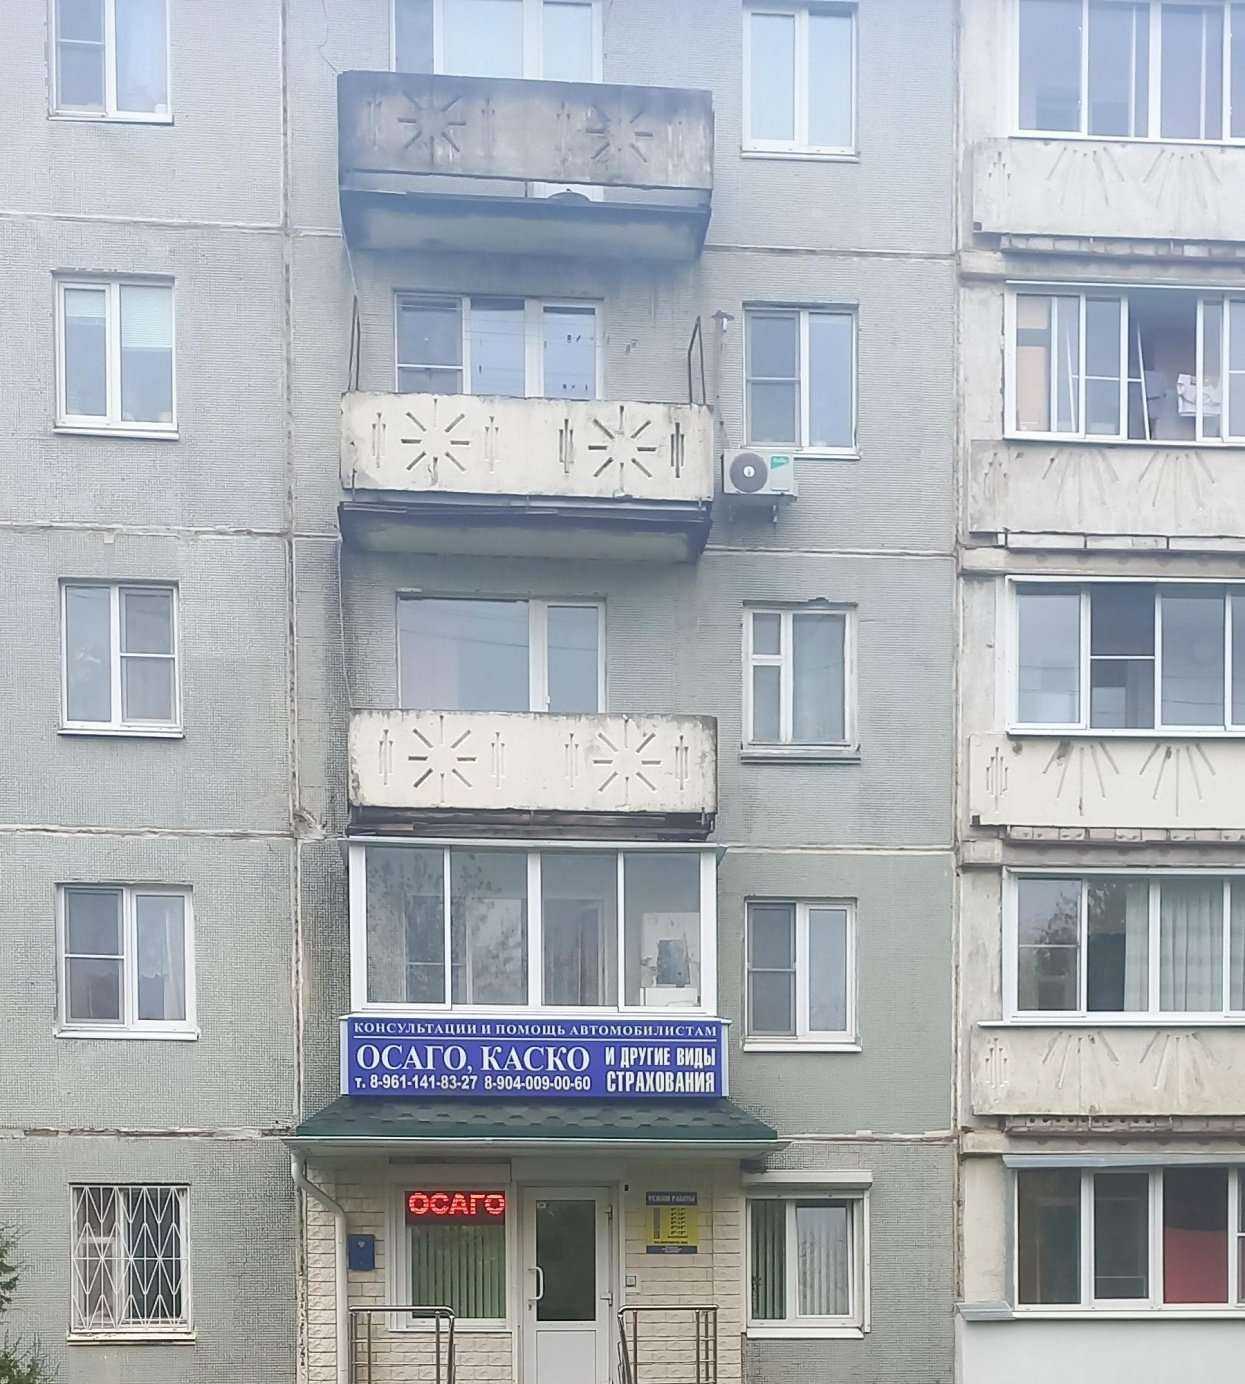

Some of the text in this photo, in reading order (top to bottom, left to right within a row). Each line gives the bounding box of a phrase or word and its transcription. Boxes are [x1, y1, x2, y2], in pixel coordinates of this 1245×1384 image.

[354, 1022, 717, 1037] КОНСУЛЬТАЦИИ И ПОМОЩЬ АВТОМОБИЛИСТАМ
[356, 1044, 590, 1073] ОСАГО, КАСКО
[605, 1047, 716, 1068] И ДРУГИЕ ВИДЫ
[355, 1074, 591, 1090] т. 8-961-141-83-27 8-904-009-00-60
[606, 1071, 715, 1092] СТРАХОВАНИЯ
[408, 1191, 505, 1215] ОСАГО
